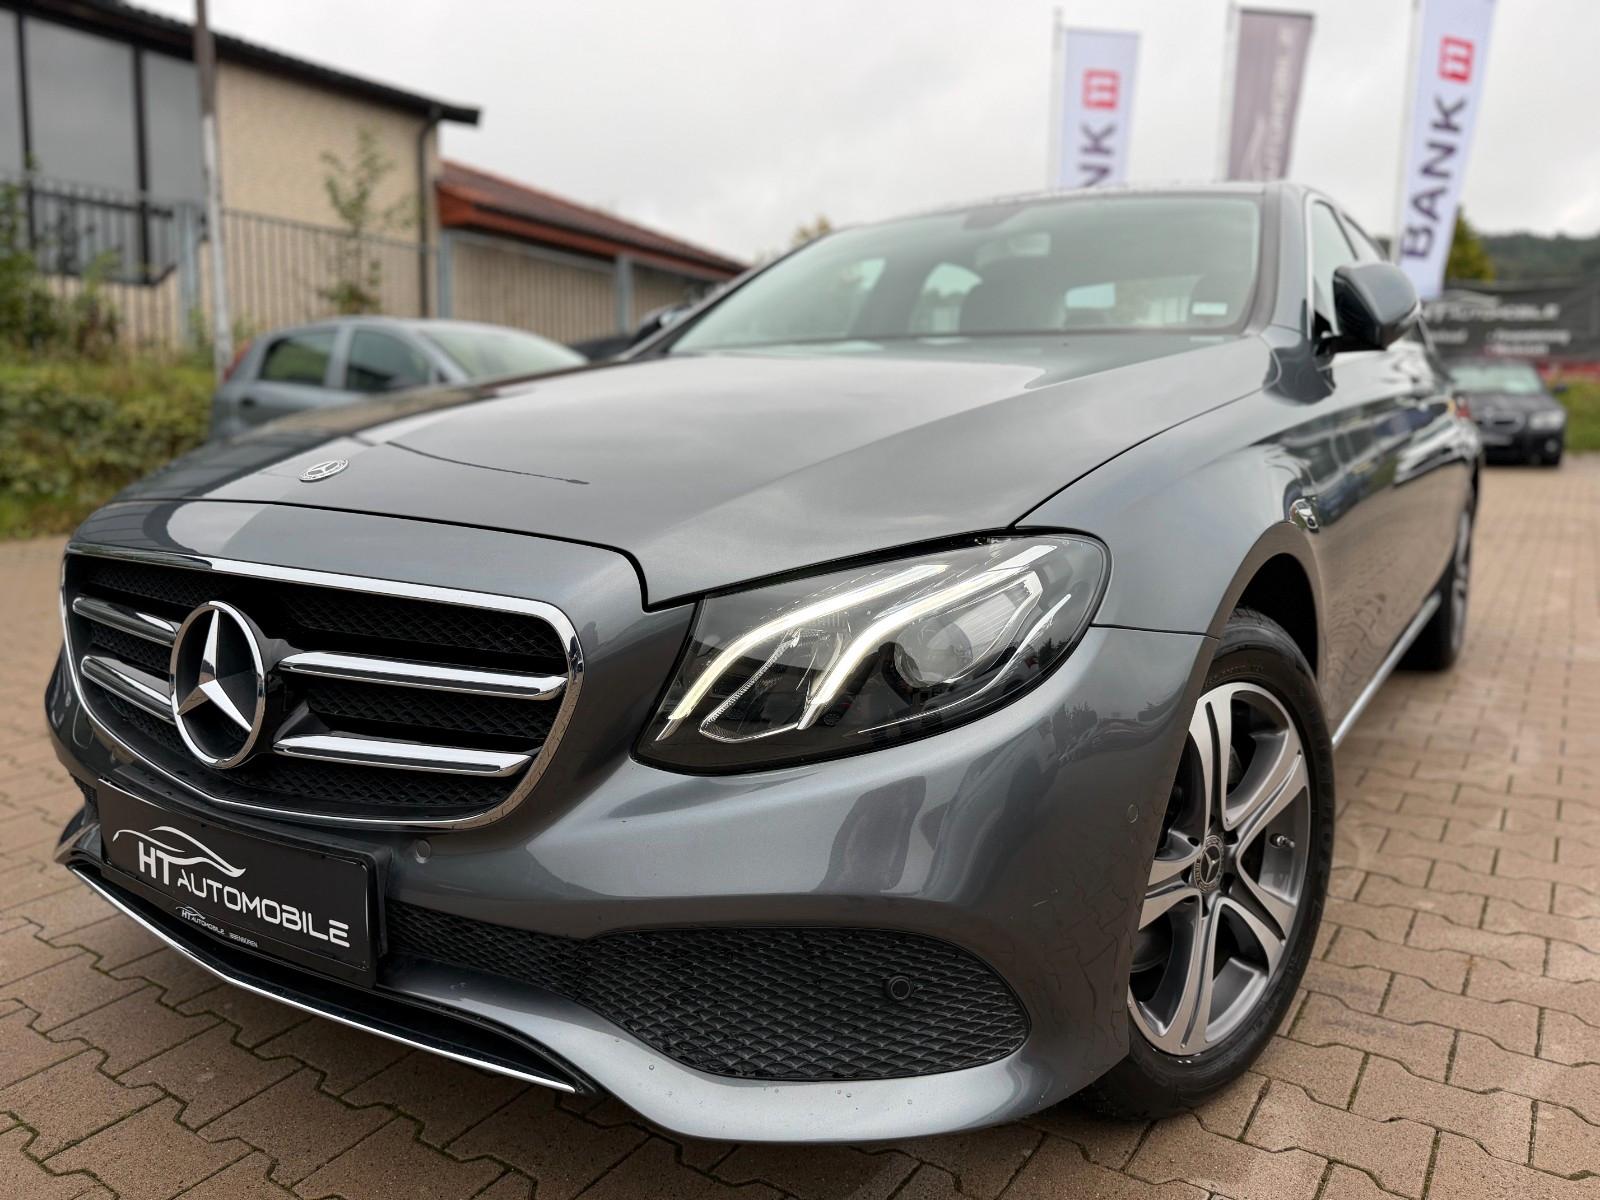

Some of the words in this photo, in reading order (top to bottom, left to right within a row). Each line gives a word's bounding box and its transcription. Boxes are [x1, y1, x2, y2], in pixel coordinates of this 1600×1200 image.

[1403, 91, 1468, 260] BANK
[138, 841, 173, 885] HT
[177, 869, 351, 948] AUTOMOBILE
